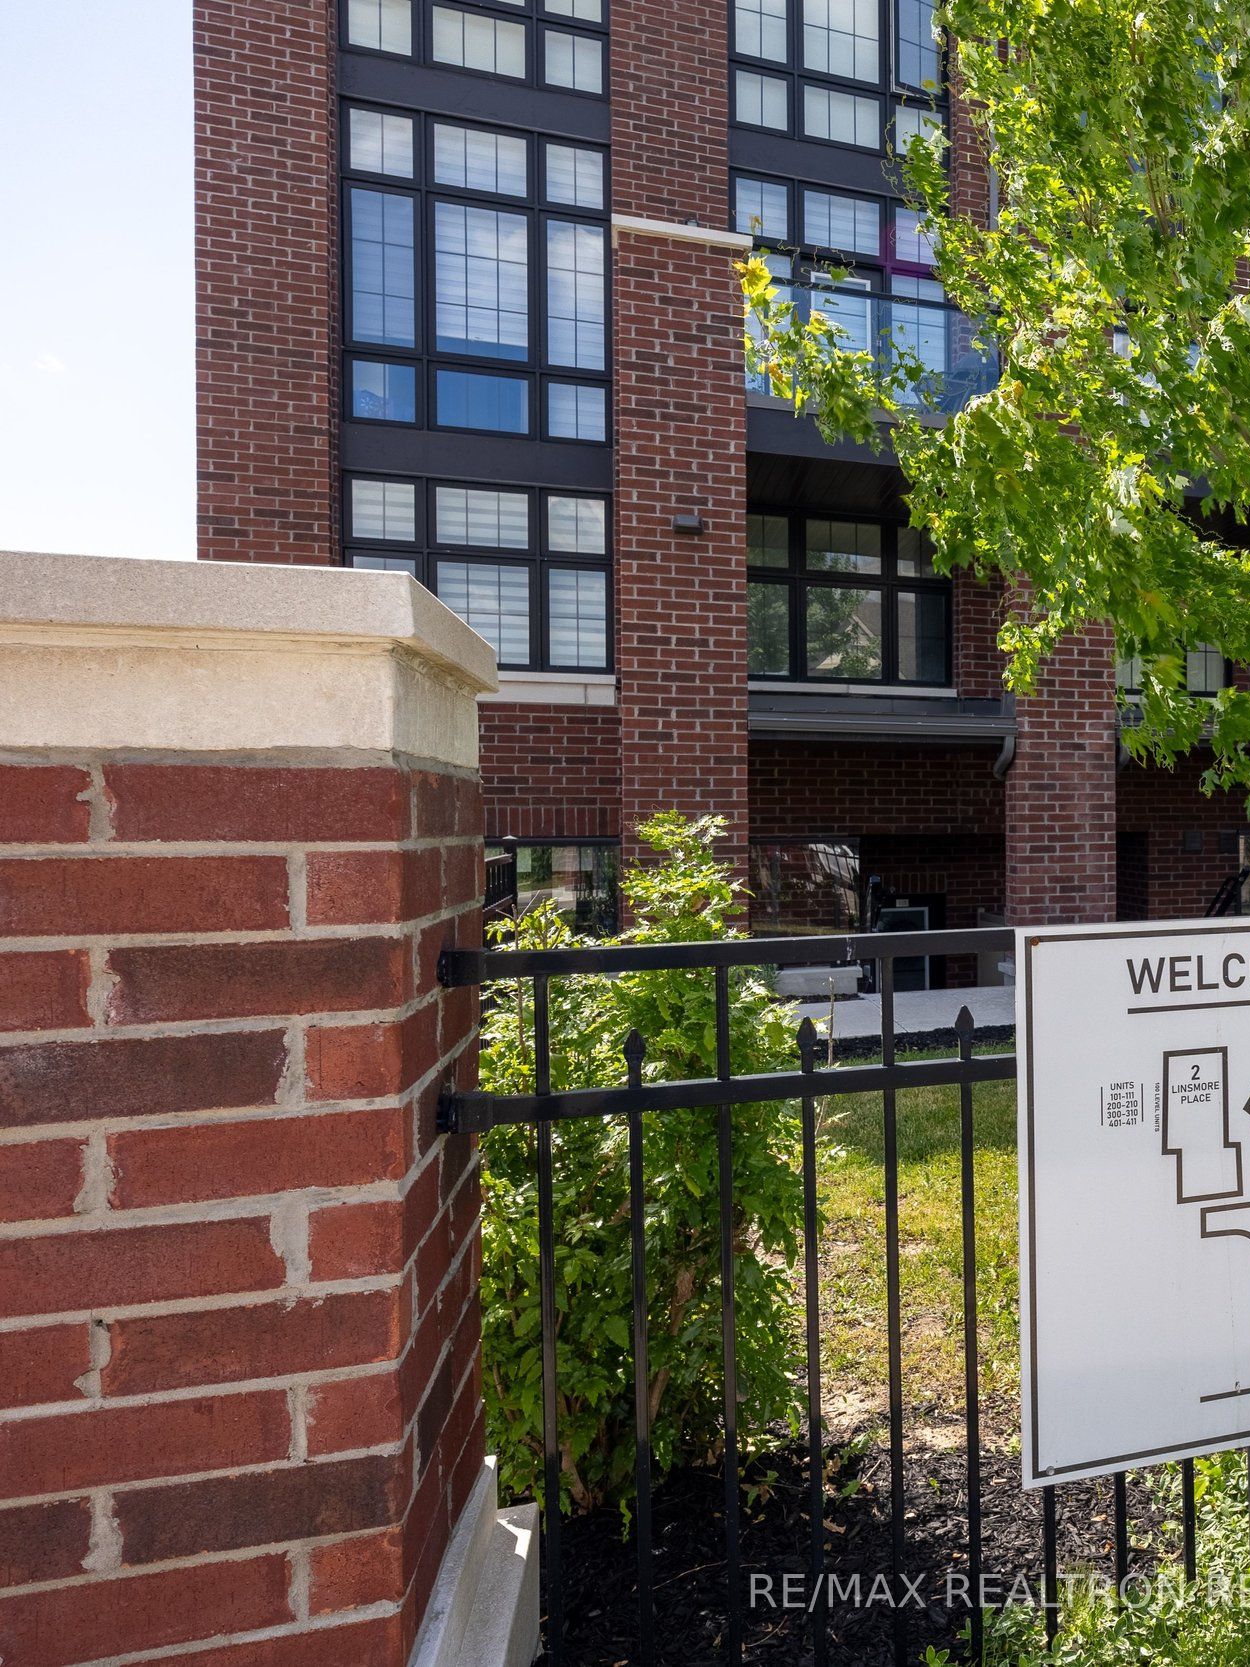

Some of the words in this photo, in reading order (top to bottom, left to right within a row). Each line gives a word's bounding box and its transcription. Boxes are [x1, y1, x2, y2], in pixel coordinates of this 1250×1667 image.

[1190, 1064, 1200, 1080] 2
[1110, 1082, 1134, 1090] UNITS
[1172, 1081, 1220, 1094] LINSMORE
[1110, 1092, 1134, 1100] 101-111
[1181, 1094, 1211, 1104] PLACE
[1107, 1100, 1138, 1110] 200-210
[1107, 1109, 1138, 1119] 300-310
[1108, 1118, 1136, 1127] 401-411
